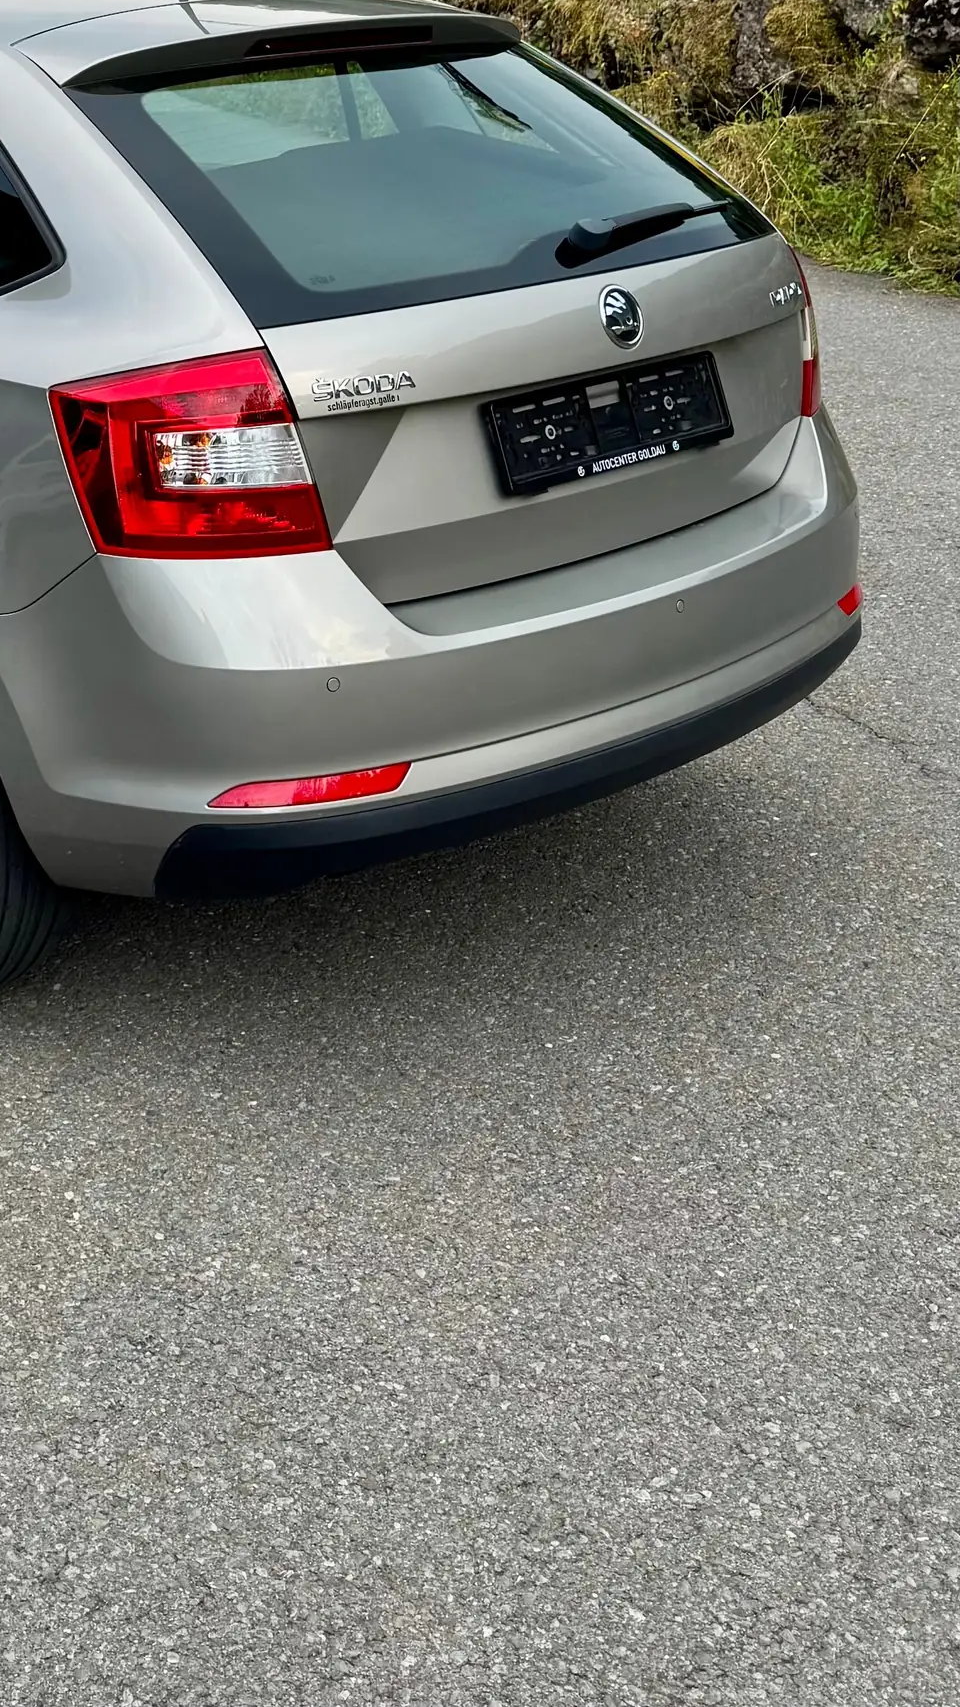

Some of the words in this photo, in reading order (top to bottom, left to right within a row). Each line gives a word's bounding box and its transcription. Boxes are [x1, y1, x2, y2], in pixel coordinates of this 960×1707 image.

[312, 370, 416, 402] ŠKODA
[592, 453, 638, 473] AUTOCENTER
[638, 444, 666, 461] GOLDAU
